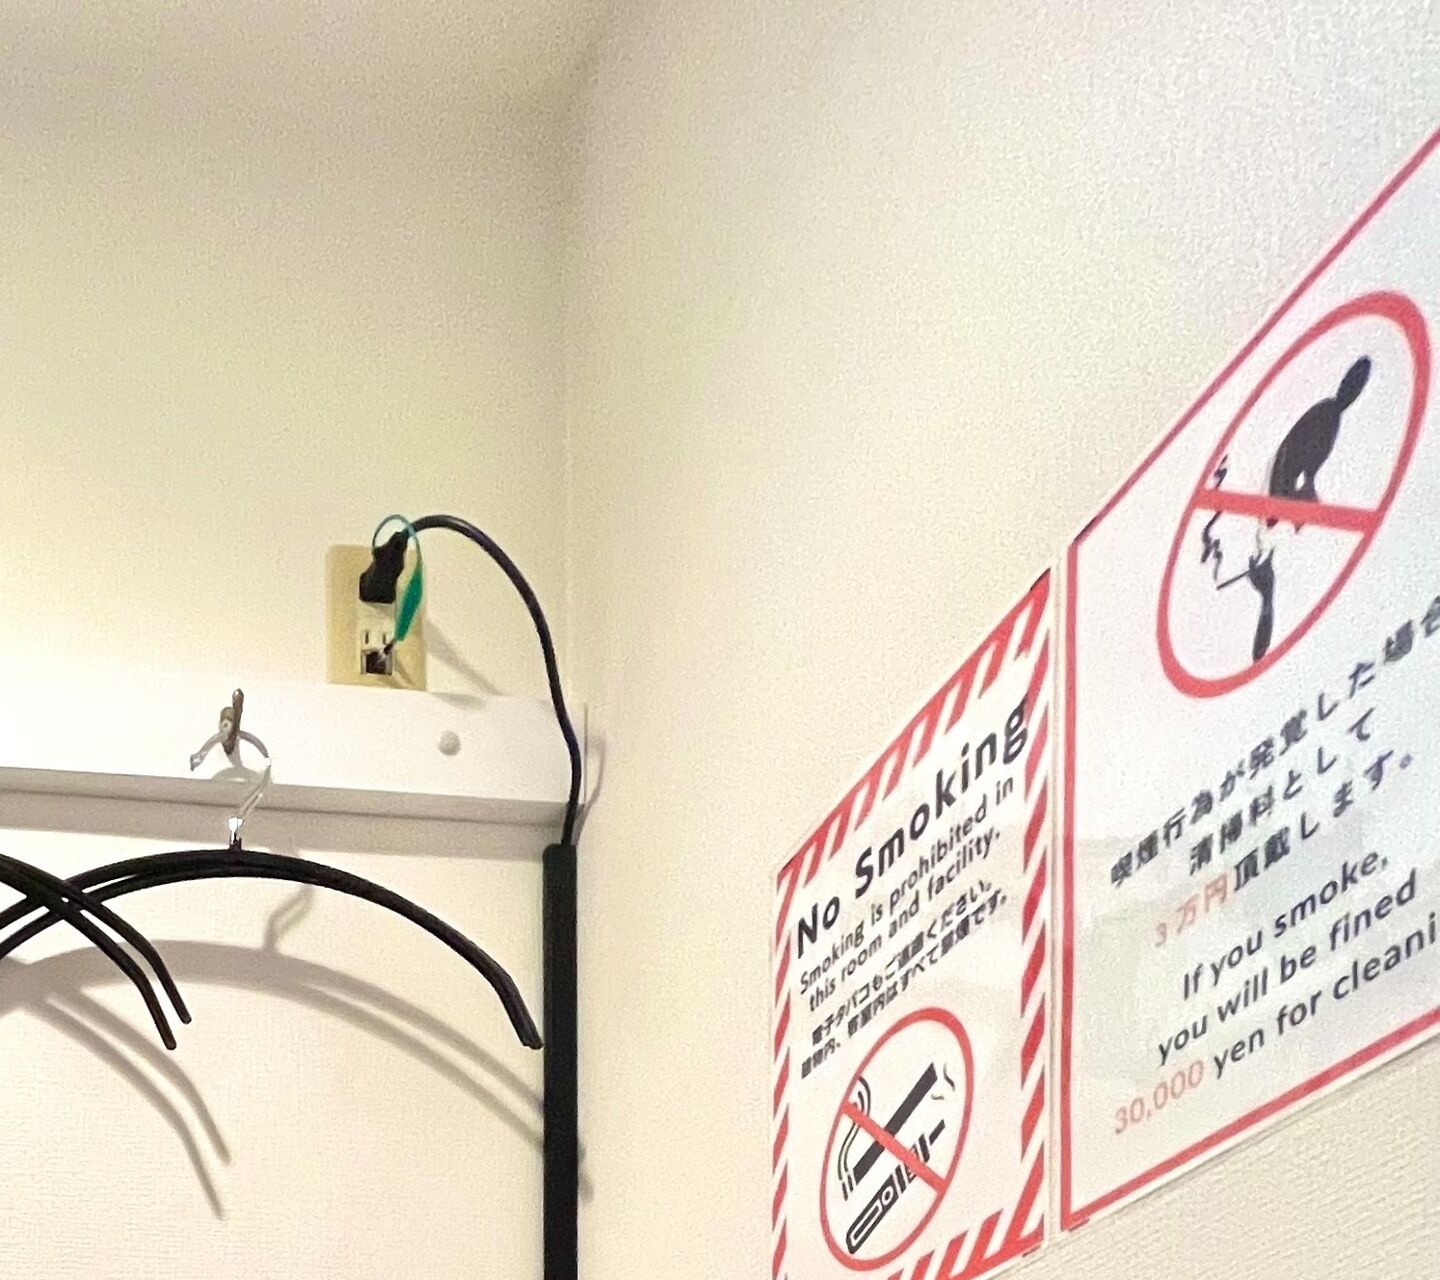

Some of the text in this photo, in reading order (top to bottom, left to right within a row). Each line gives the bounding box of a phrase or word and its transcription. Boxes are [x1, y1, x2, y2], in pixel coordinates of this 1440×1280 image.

[798, 692, 1029, 959] No Smoking
[800, 776, 1013, 995] Smoking is prohibited in
[809, 827, 1001, 1012] this room and facility.
[812, 879, 993, 1046] 子タバコもごください。
[1158, 867, 1417, 1066] you will be fined
[1183, 851, 1388, 1000] If you smoke,
[1213, 1028, 1264, 1079] yen
[1277, 990, 1322, 1035] for
